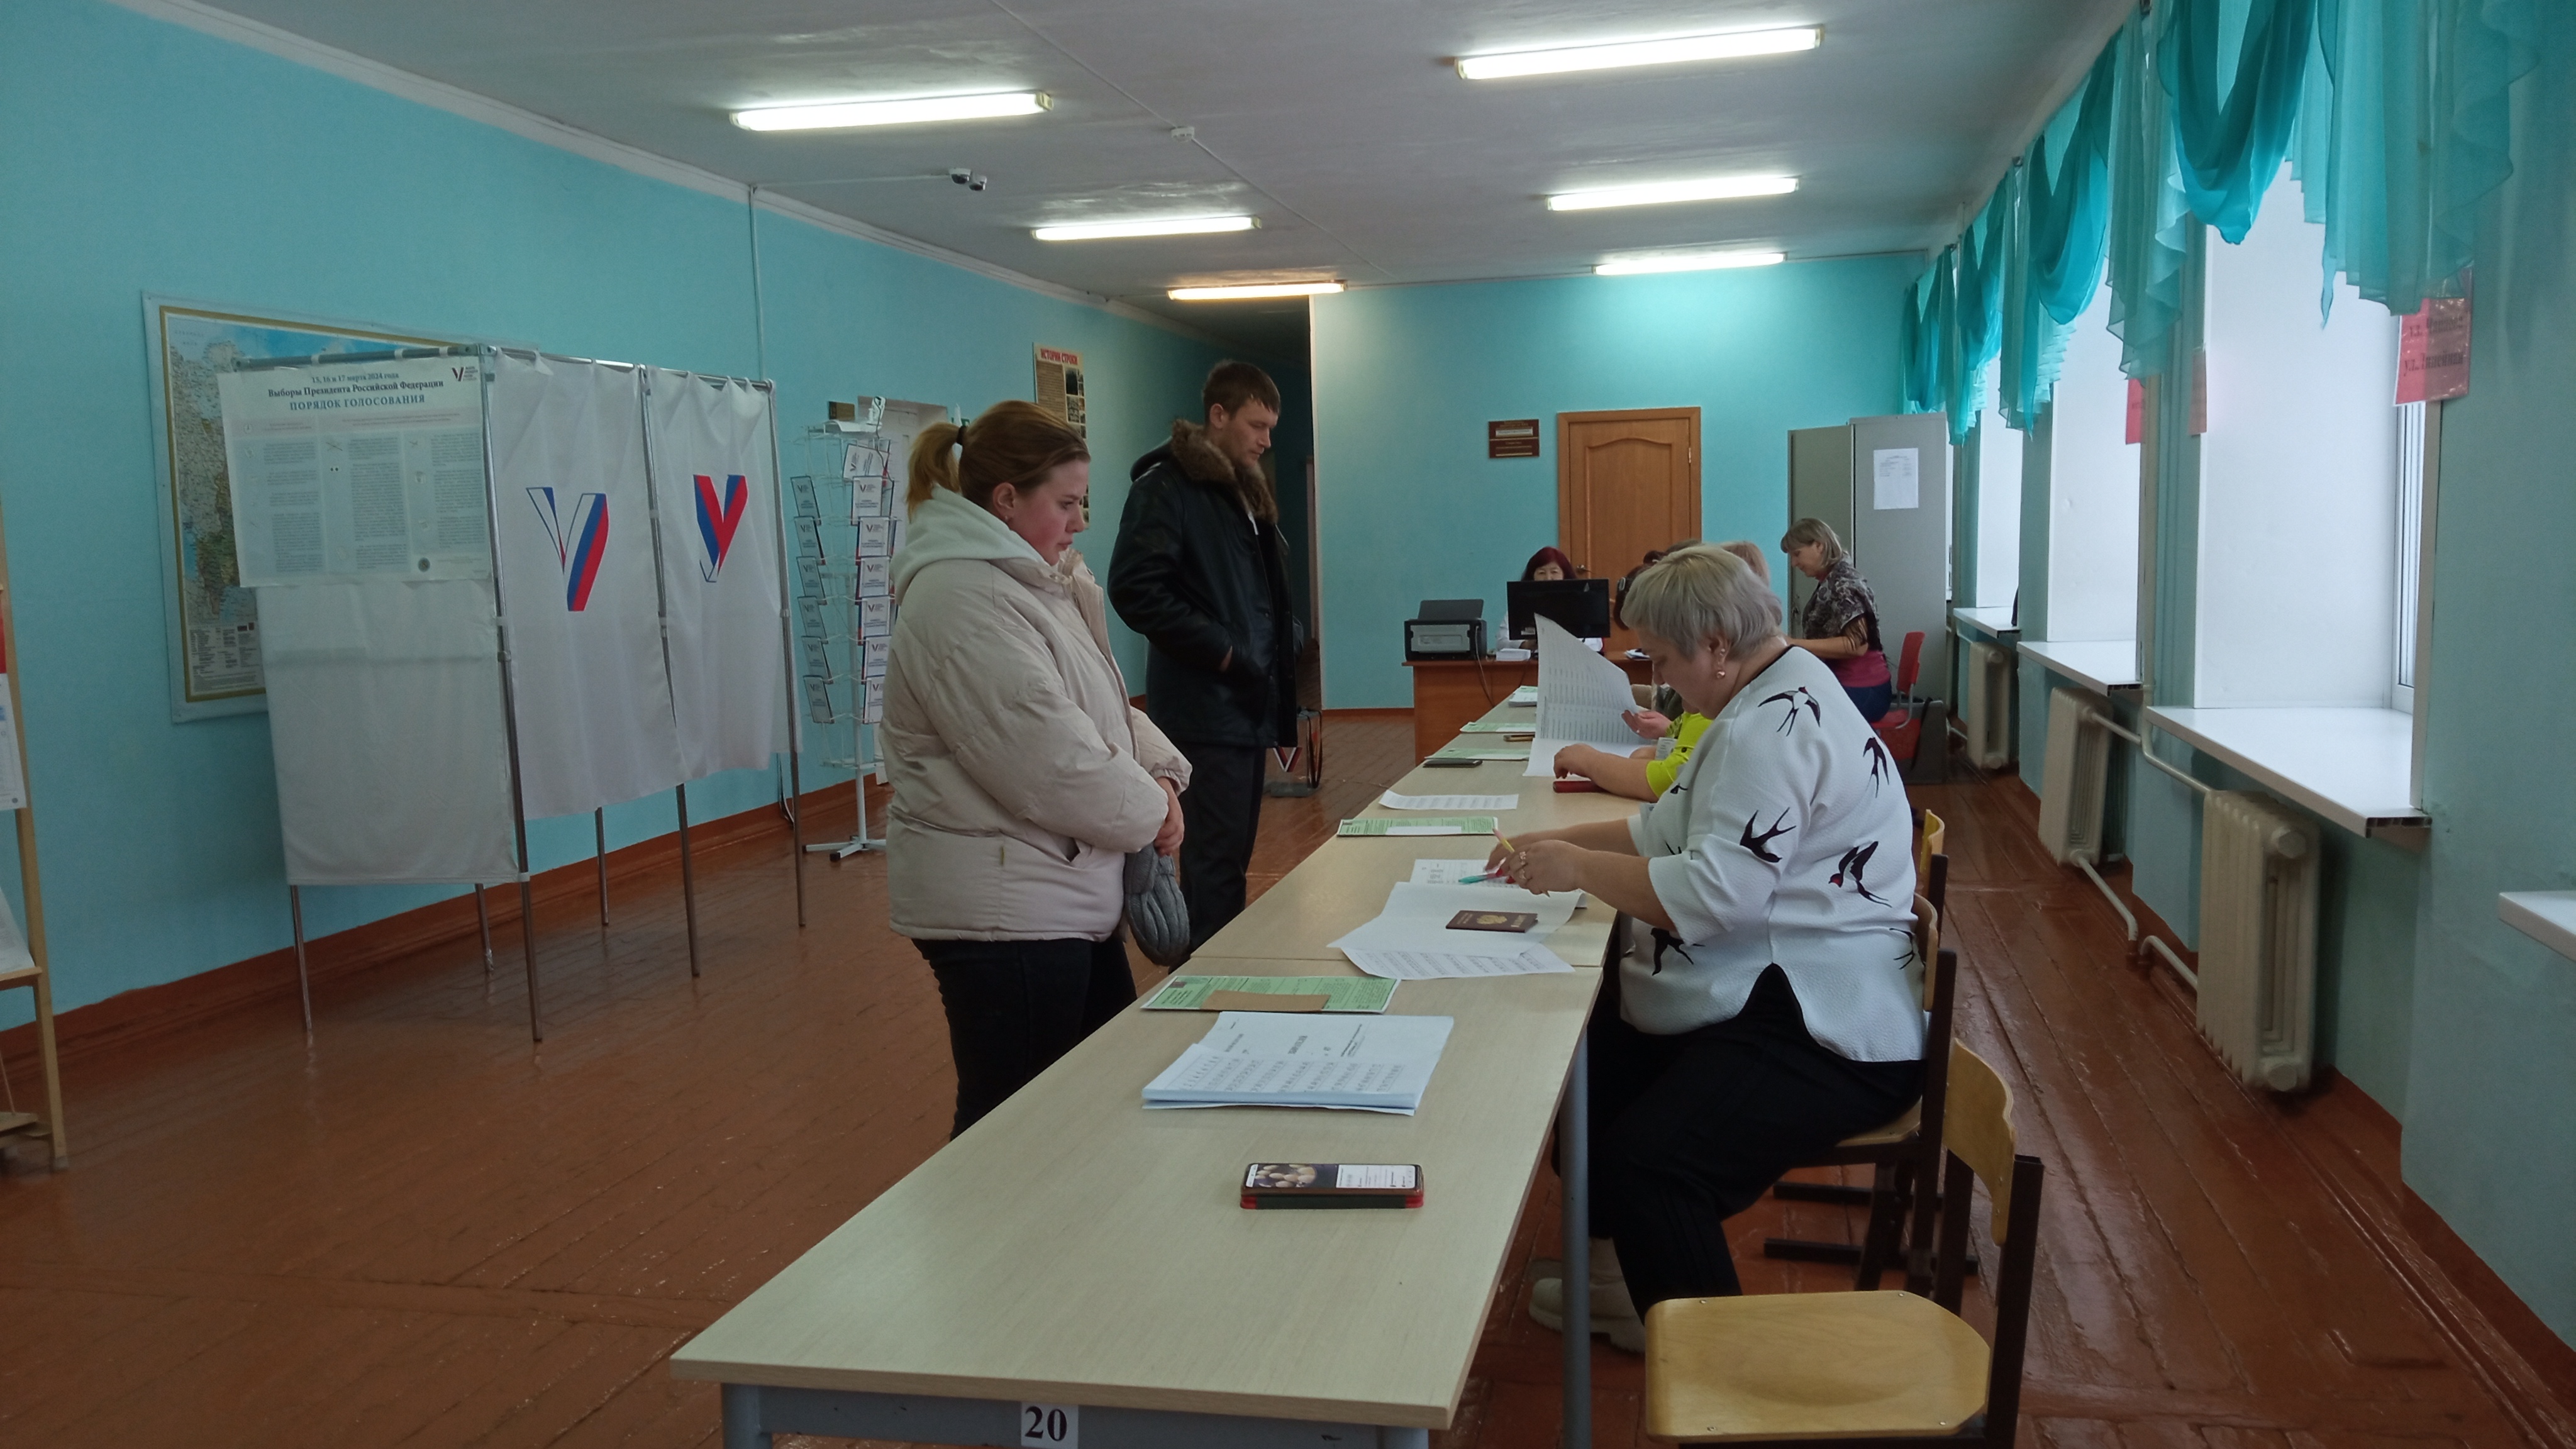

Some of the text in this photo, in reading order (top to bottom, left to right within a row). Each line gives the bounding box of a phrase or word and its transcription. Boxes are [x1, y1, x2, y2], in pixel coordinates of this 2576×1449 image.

[269, 380, 444, 398] Выборы Президента Российской Федерации
[290, 394, 425, 410] ПОРЯДОК ГОЛОСОВАНИЯ
[1024, 1406, 1067, 1441] 20
